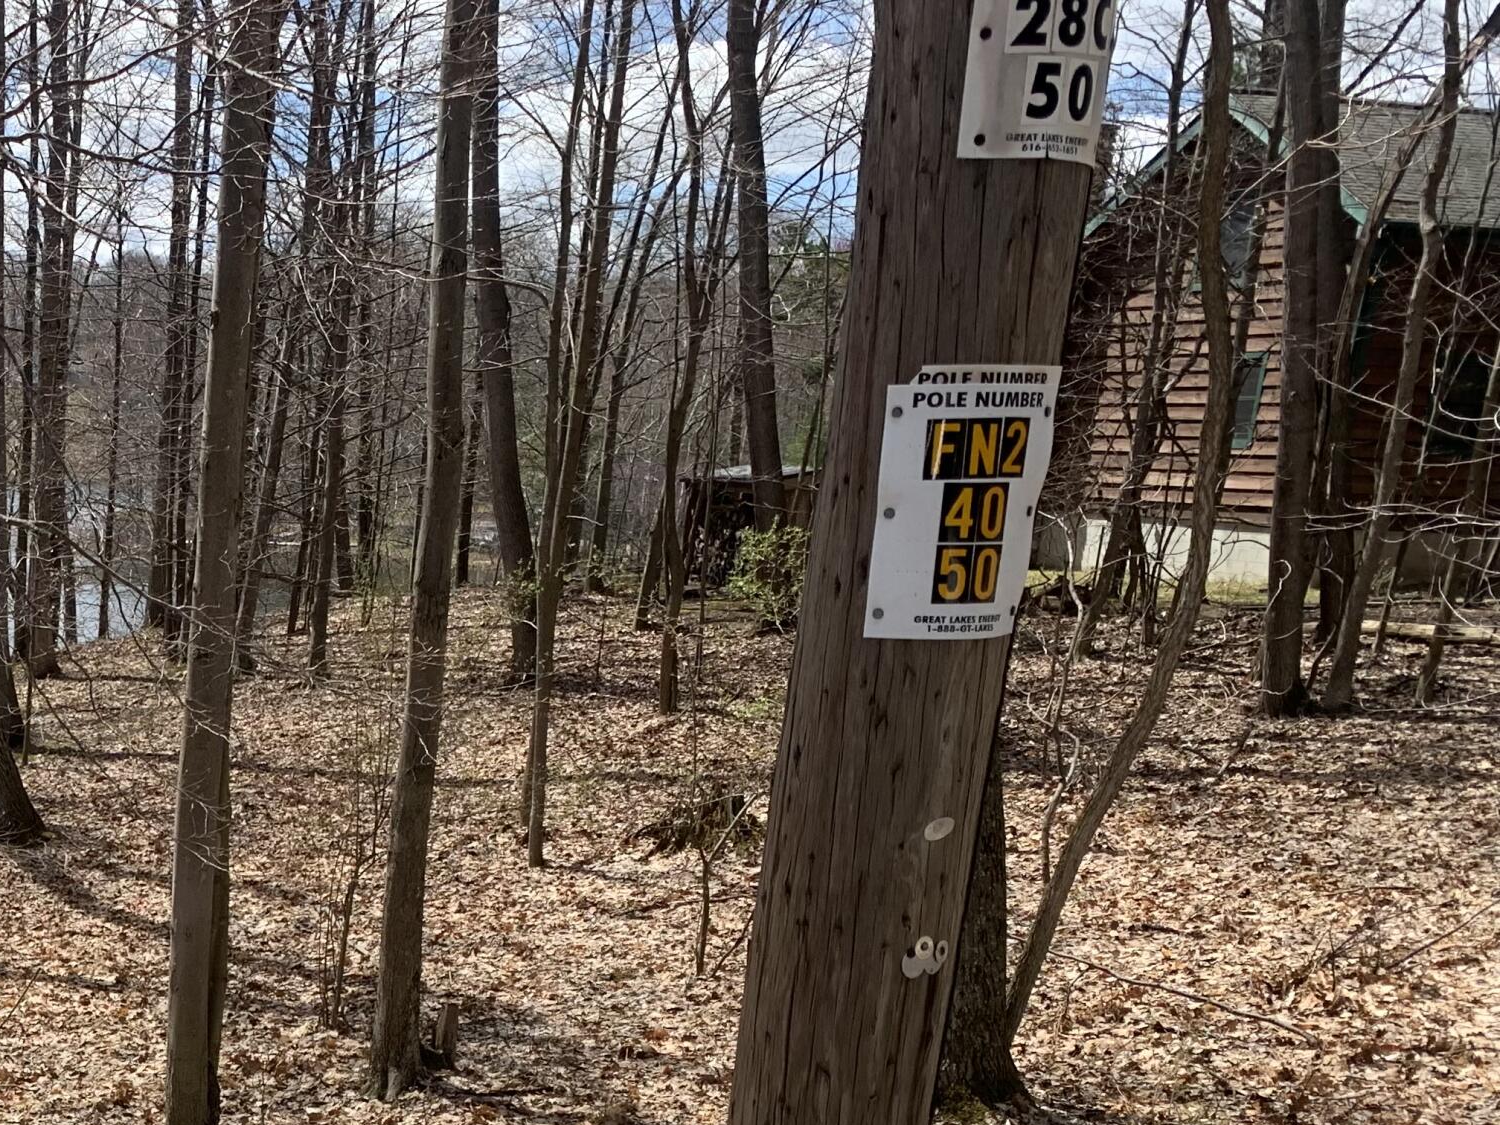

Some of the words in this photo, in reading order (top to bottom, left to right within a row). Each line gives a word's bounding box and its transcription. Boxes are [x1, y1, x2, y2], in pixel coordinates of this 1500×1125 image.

[1026, 62, 1093, 121] 50
[912, 391, 968, 408] POLE
[975, 391, 1044, 408] NUMBER
[930, 421, 1027, 476] FN2
[944, 486, 1005, 539] 40
[937, 548, 998, 600] 50
[914, 615, 946, 624] GREAT
[949, 615, 976, 624] LAKES
